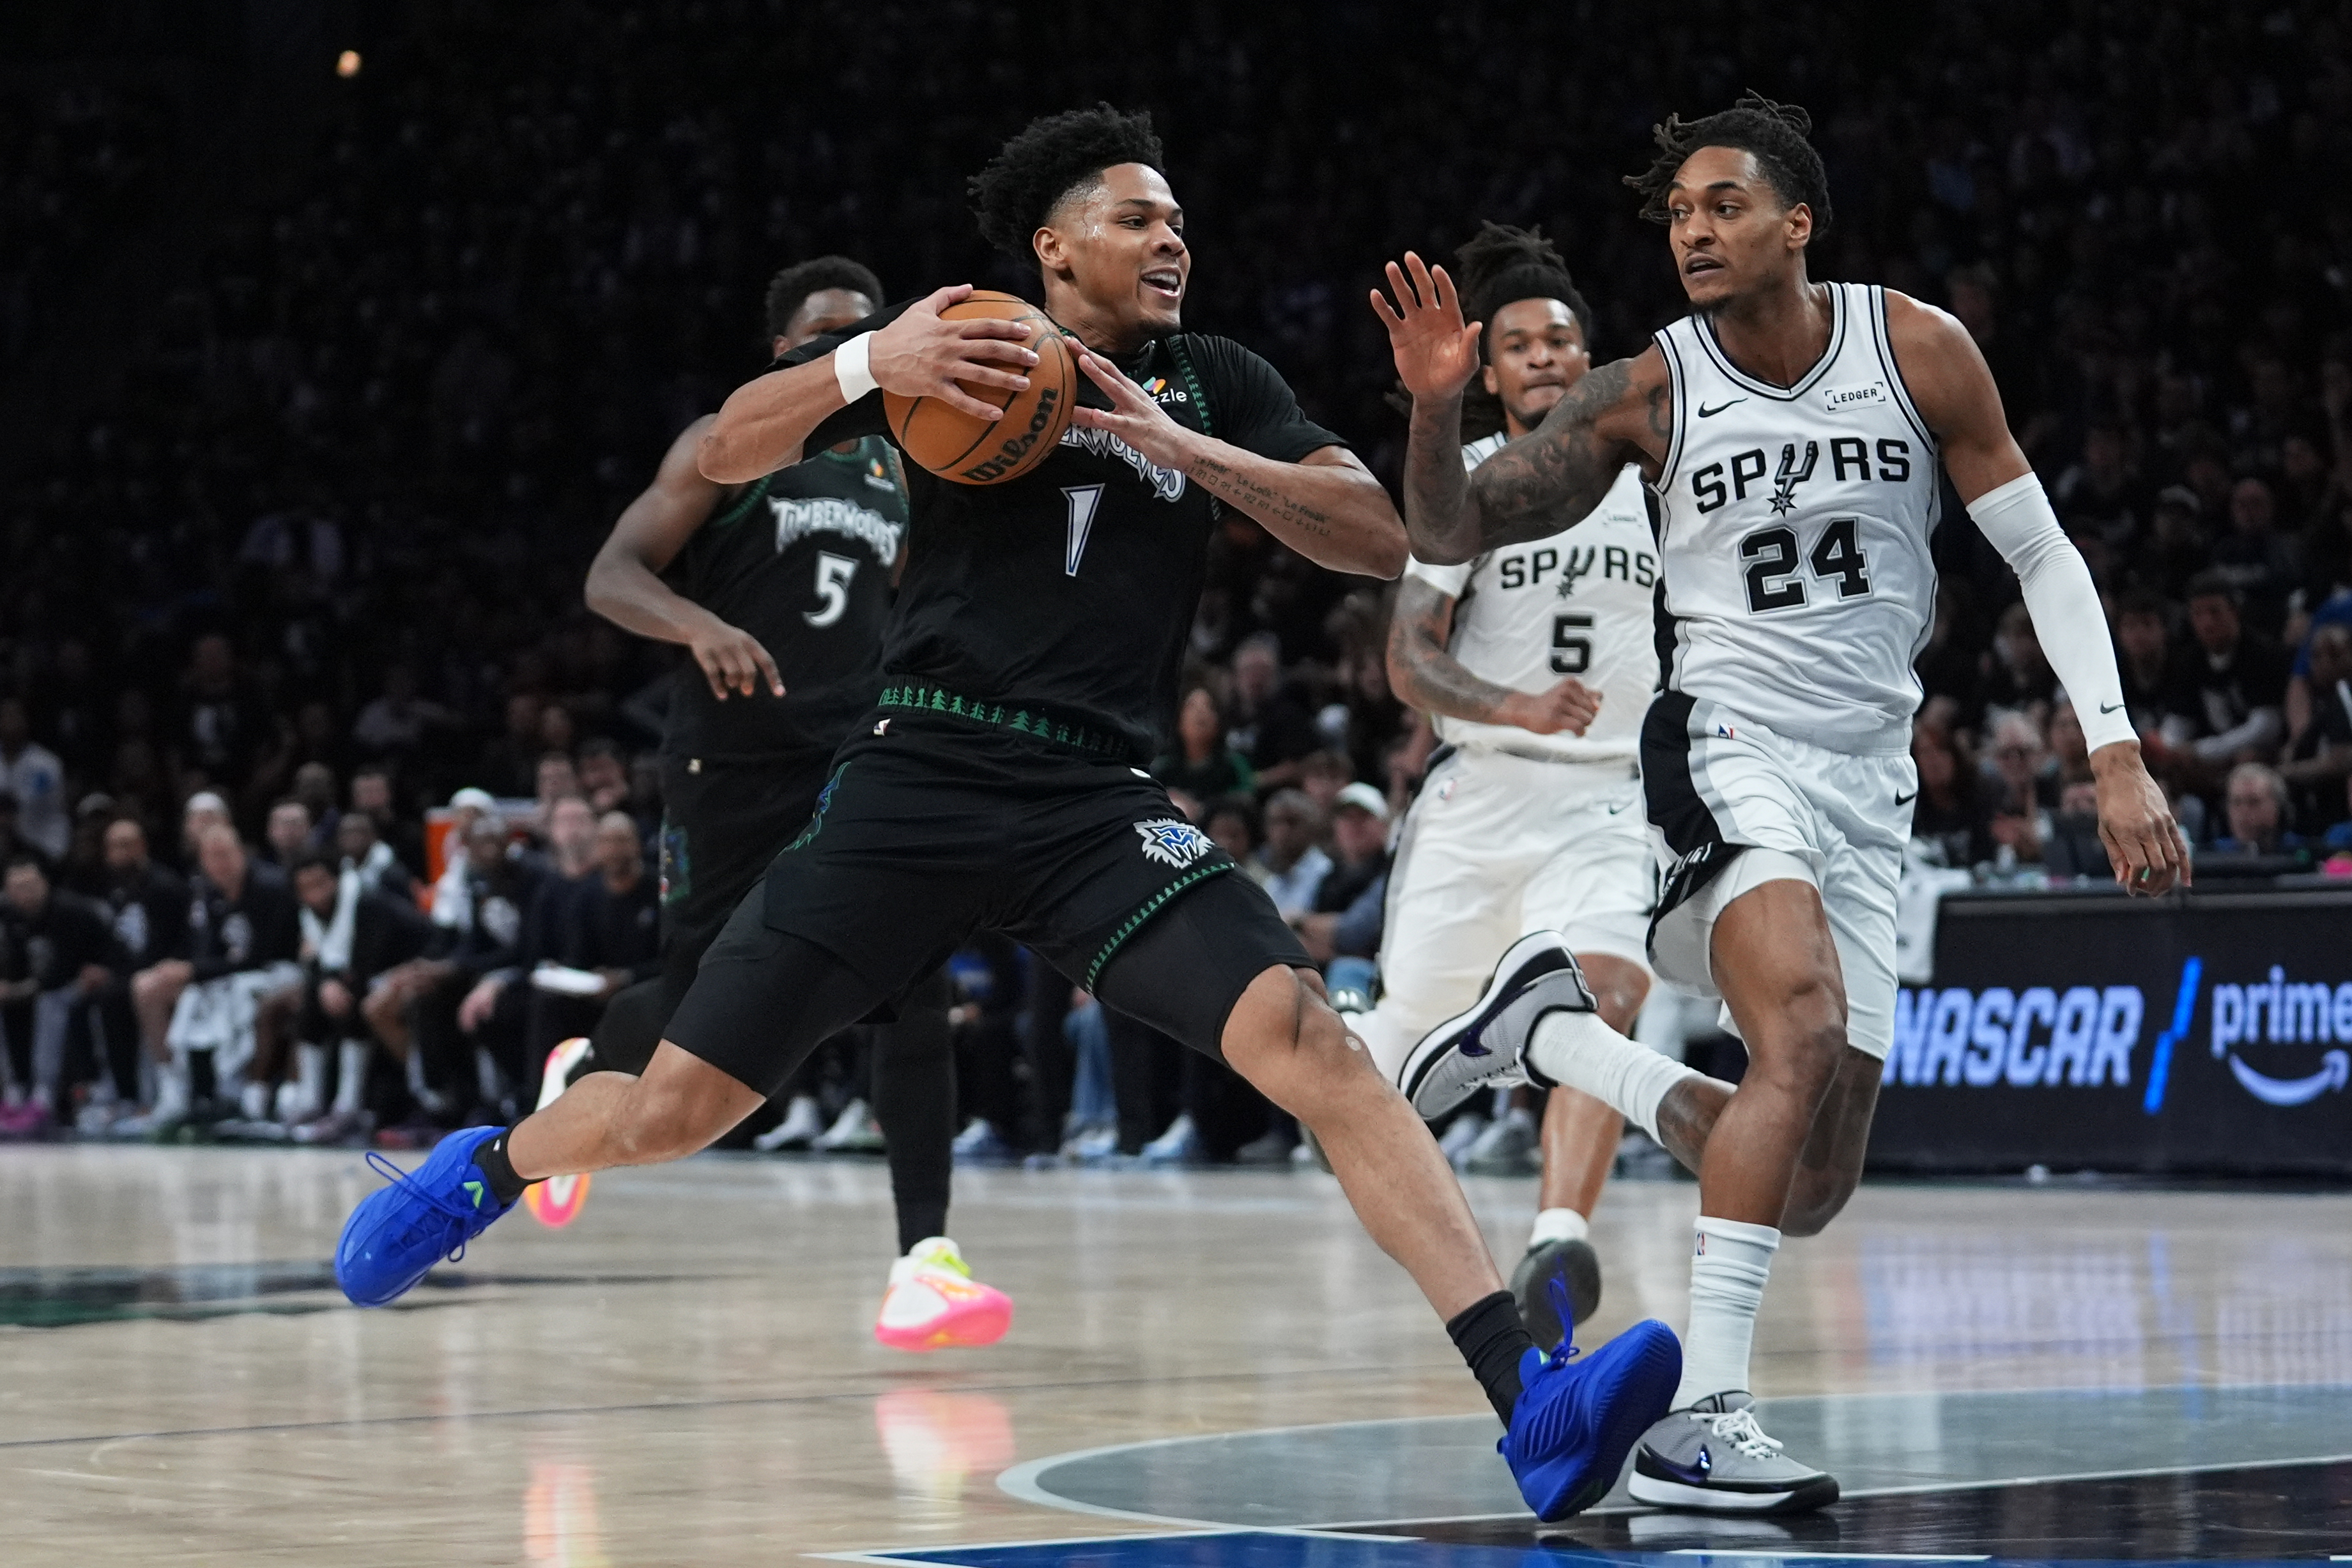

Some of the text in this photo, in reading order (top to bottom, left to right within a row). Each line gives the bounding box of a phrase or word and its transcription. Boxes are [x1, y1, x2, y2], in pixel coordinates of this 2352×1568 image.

[960, 387, 1058, 481] Wilson
[1151, 388, 1187, 403] zzle
[1833, 388, 1878, 404] LEDGER
[1692, 437, 1910, 518] SPURS
[1059, 482, 1105, 577] 1
[1738, 517, 1873, 615] 24
[802, 551, 860, 627] 5
[1500, 546, 1655, 599] SPURS
[1549, 612, 1595, 675] 5
[1881, 964, 2352, 1086] NASCAR prime
